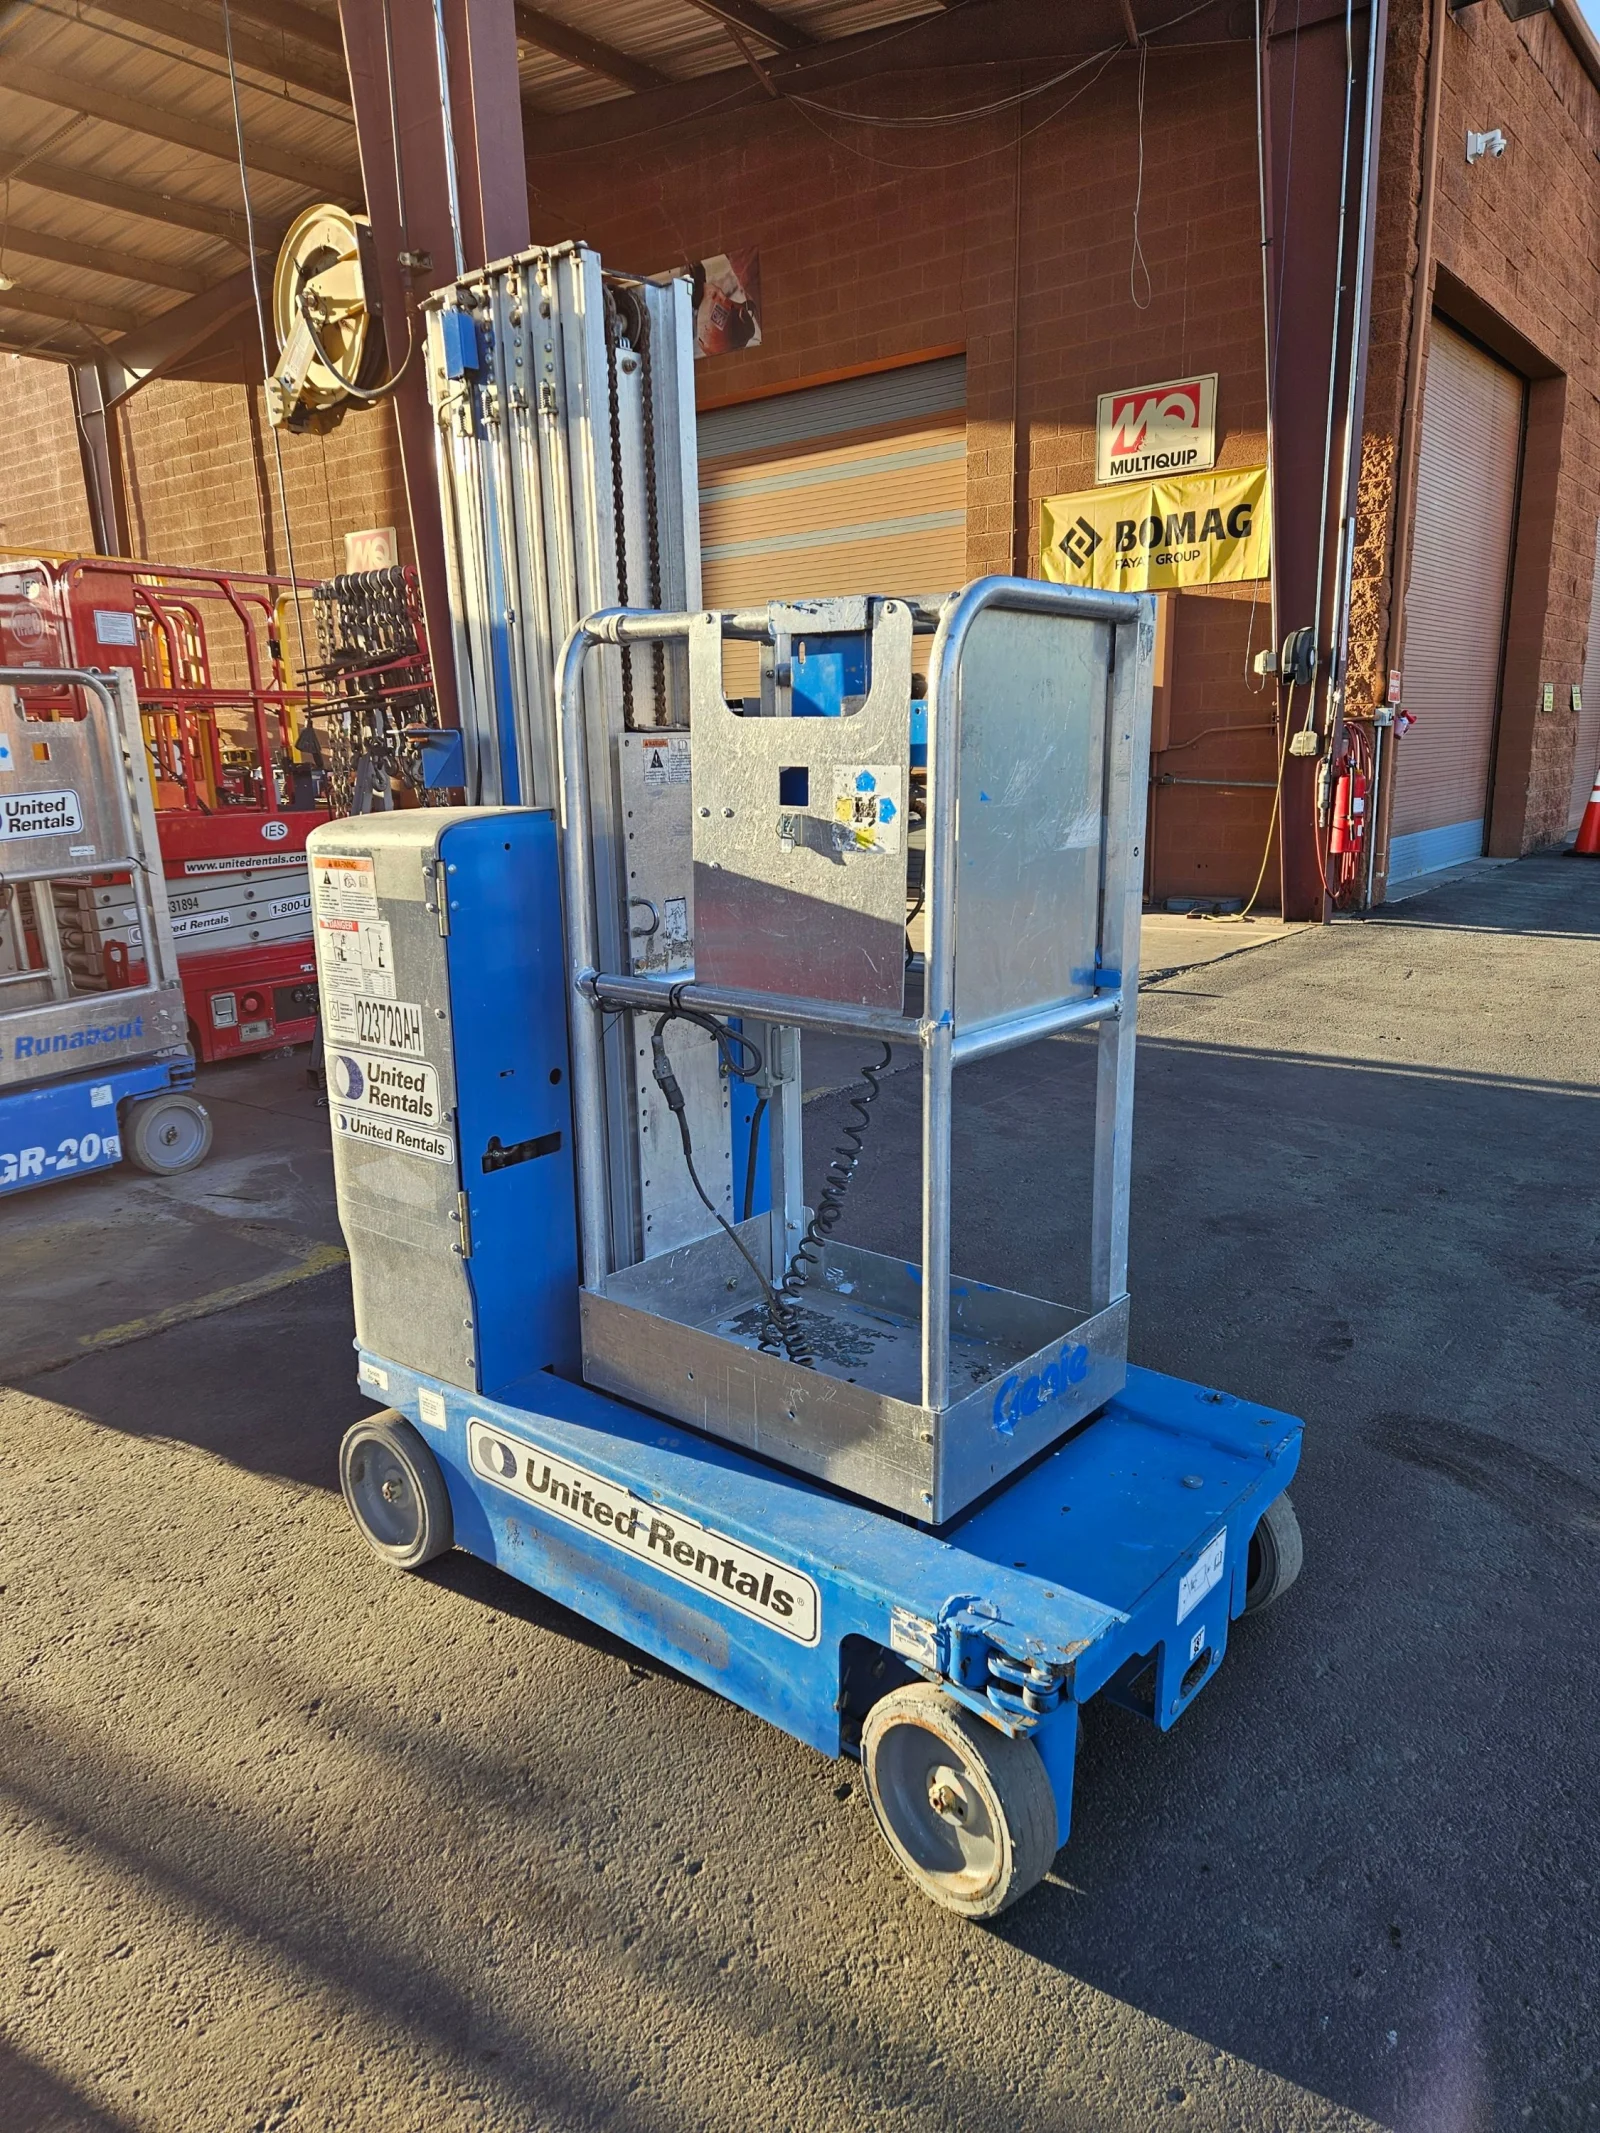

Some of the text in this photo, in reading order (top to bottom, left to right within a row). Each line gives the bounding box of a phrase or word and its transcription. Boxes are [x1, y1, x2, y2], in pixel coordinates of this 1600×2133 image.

[1111, 391, 1199, 449] MQ
[1110, 449, 1198, 476] MULTIQUIP
[1115, 503, 1252, 553] BOMAG
[1156, 550, 1201, 566] GROUP
[22, 580, 37, 595] IE
[5, 797, 66, 817] United
[8, 813, 75, 833] Rentals
[264, 824, 285, 838] IES
[190, 915, 229, 929] Rentals
[15, 1016, 144, 1060] Runabout
[357, 1000, 422, 1051] 223720AH
[367, 1062, 426, 1093] United
[369, 1085, 434, 1117] Rentals
[350, 1117, 445, 1156] United Rentals
[526, 1458, 795, 1618] United Rentals
